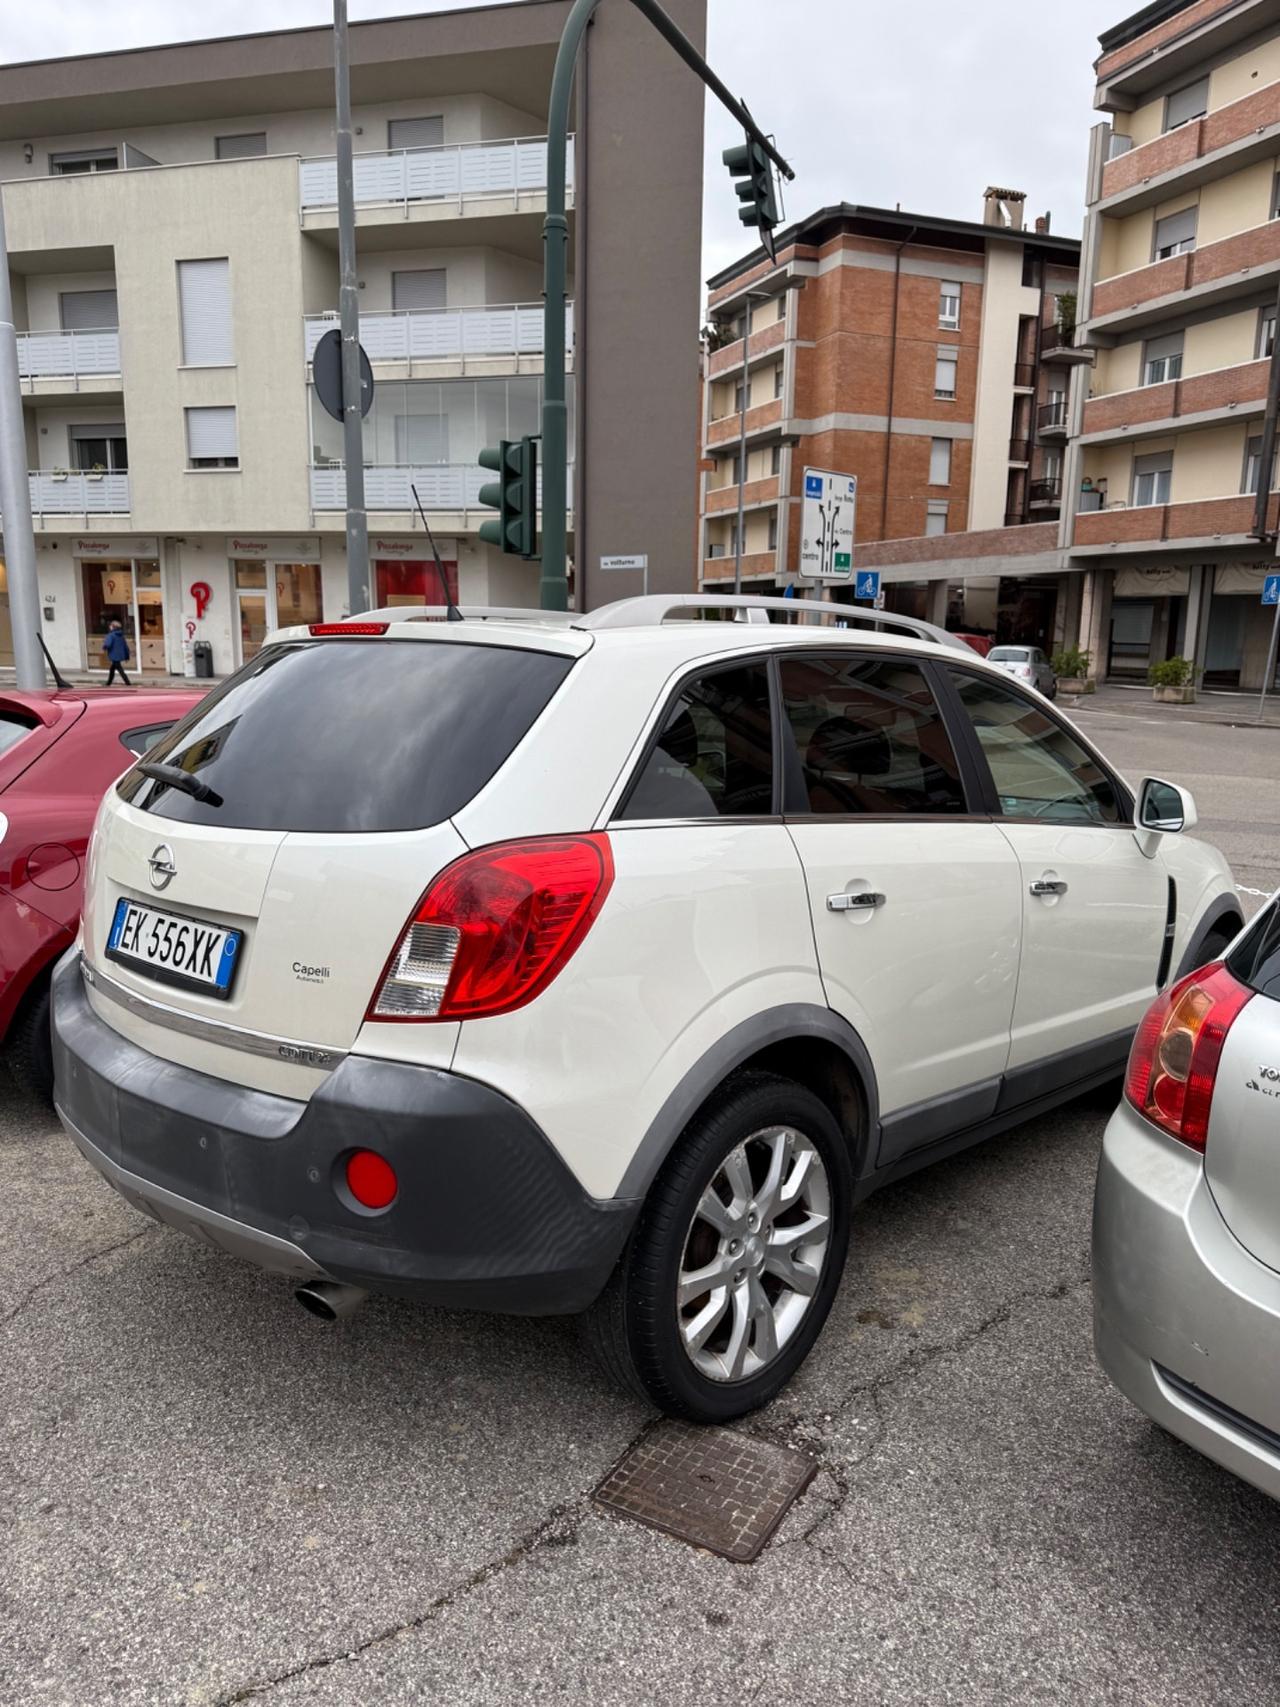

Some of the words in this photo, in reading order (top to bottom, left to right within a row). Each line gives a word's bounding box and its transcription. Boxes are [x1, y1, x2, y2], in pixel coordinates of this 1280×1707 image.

[120, 909, 148, 953] EK
[148, 918, 221, 978] 556XK
[292, 962, 330, 978] Capelli
